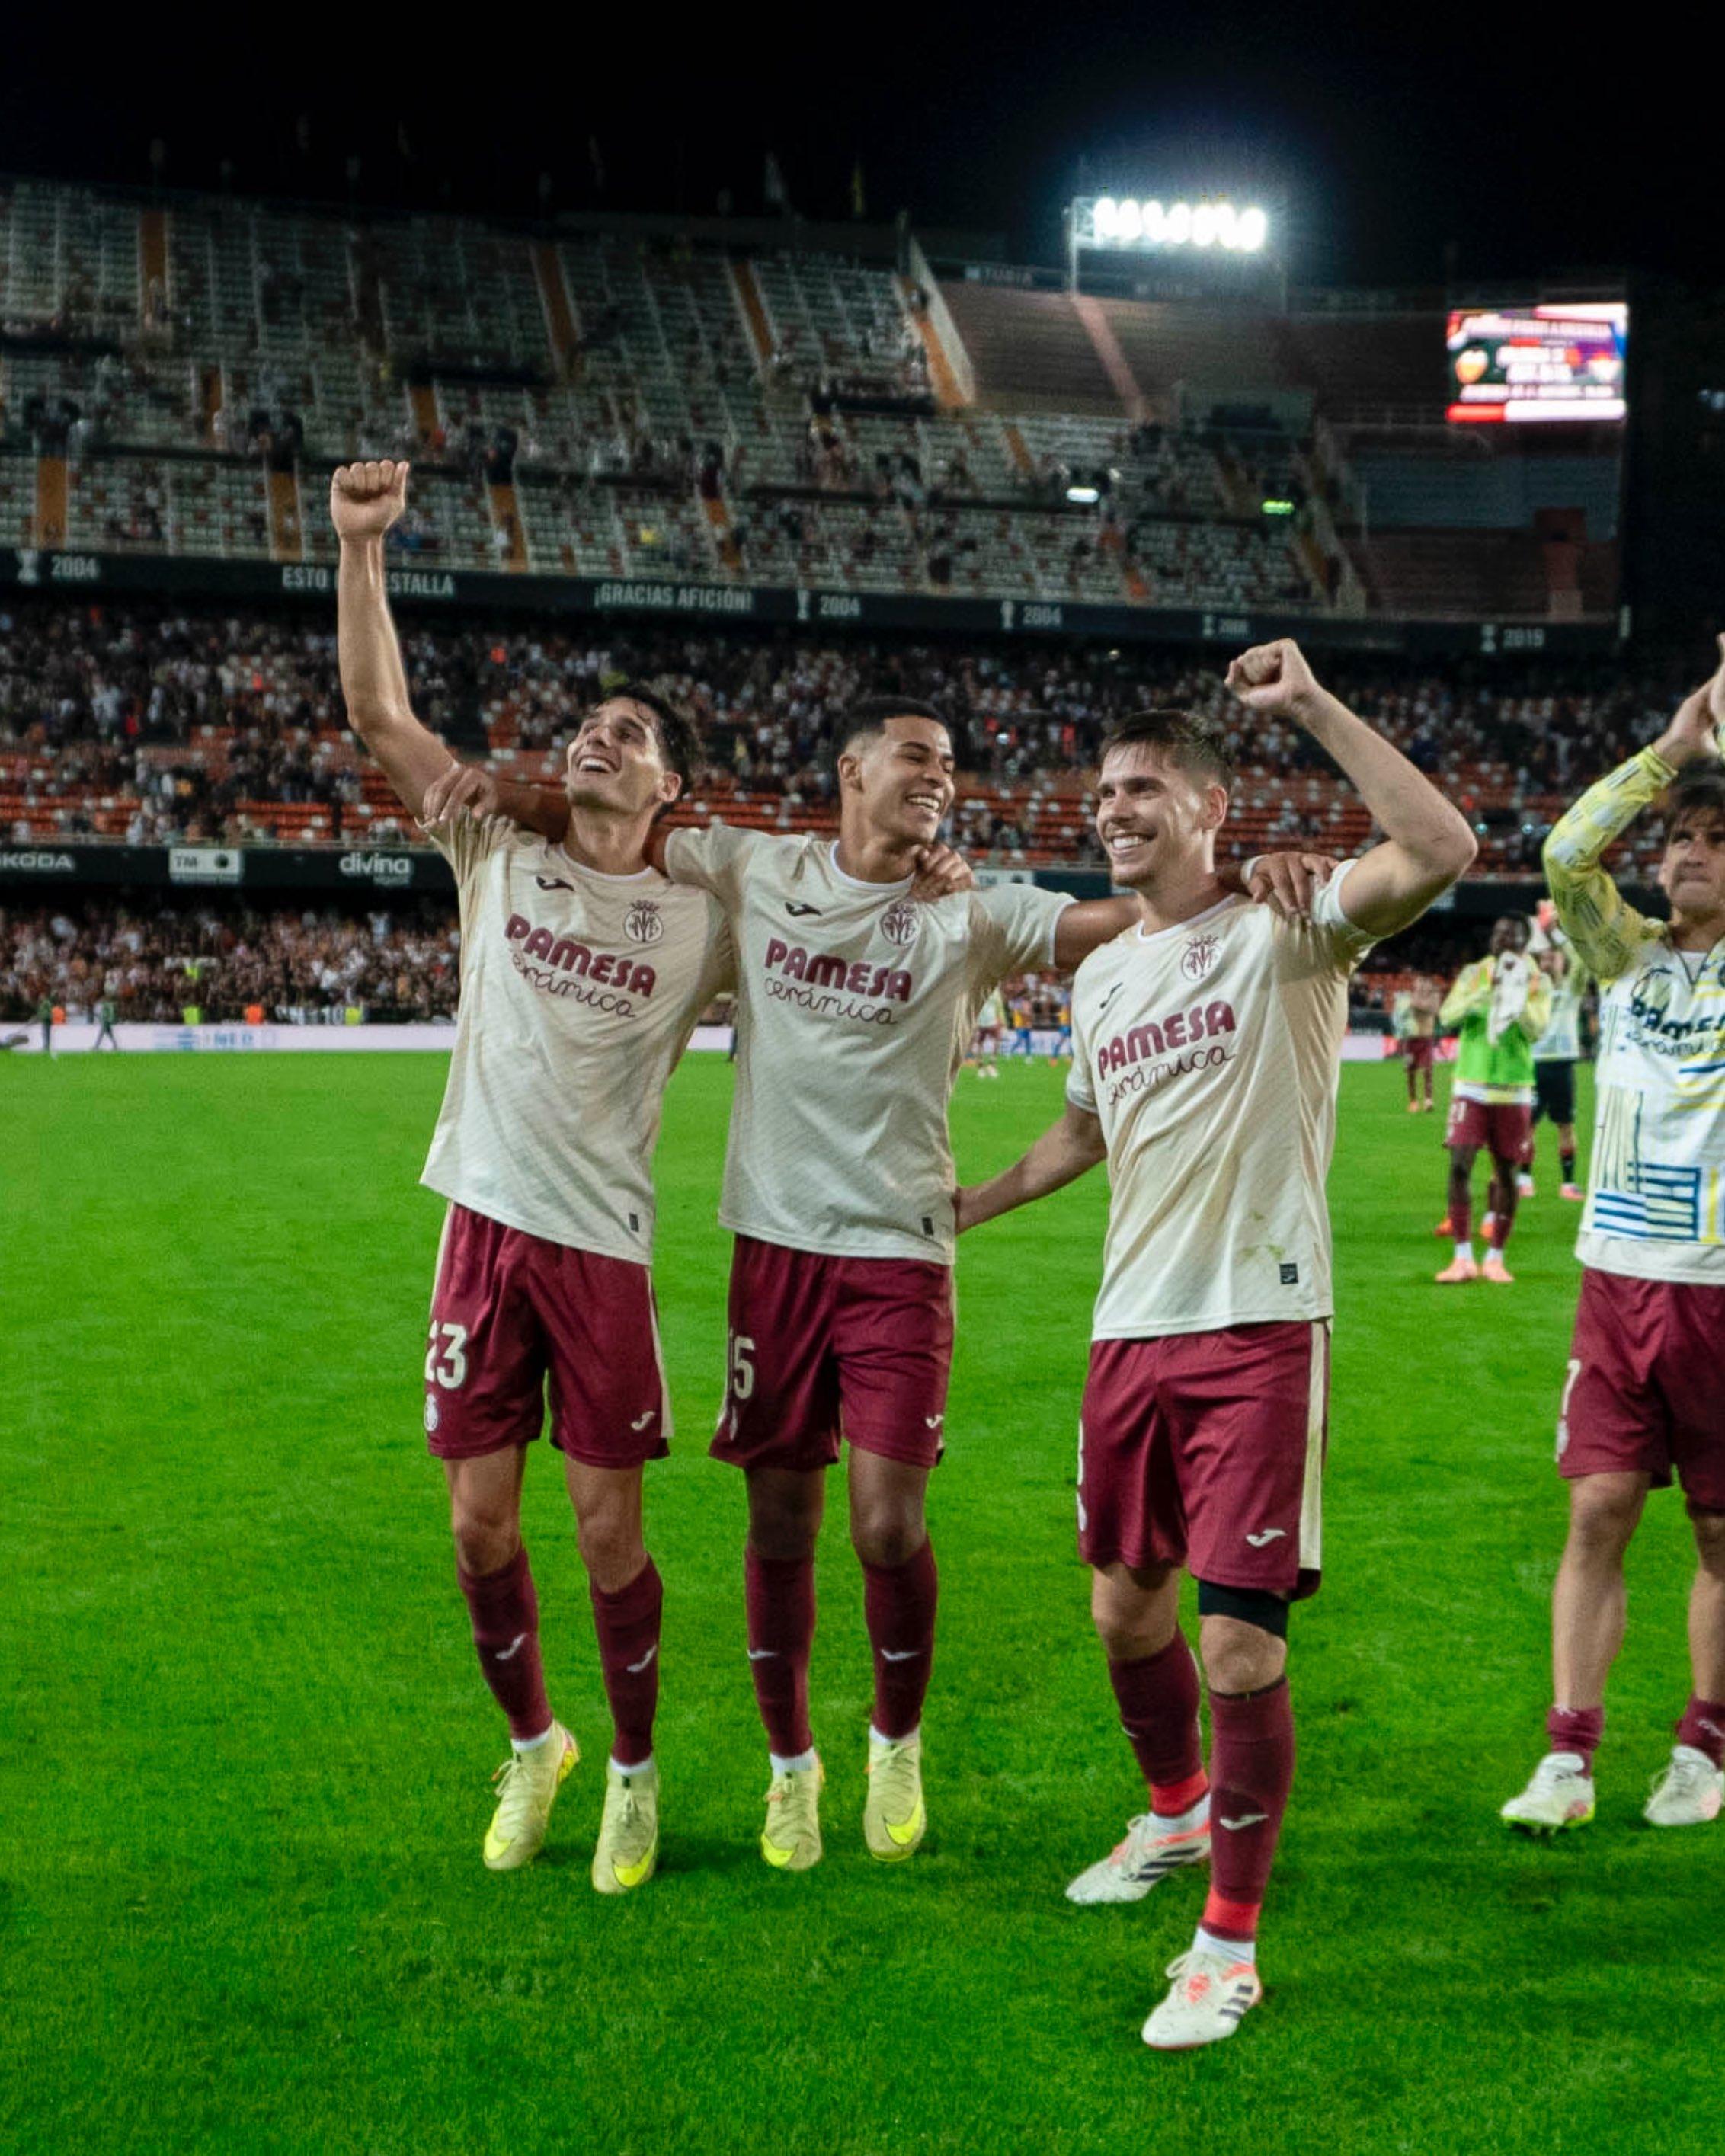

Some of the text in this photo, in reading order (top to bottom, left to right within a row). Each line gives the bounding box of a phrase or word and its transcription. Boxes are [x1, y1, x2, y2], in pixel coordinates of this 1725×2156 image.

[281, 565, 456, 595] ESTO STALLA
[2, 851, 74, 869] KODA
[339, 851, 411, 875] divina
[504, 913, 657, 998] PAMESA
[764, 937, 912, 1002] PAMESA
[1098, 1000, 1237, 1081] PAMESA
